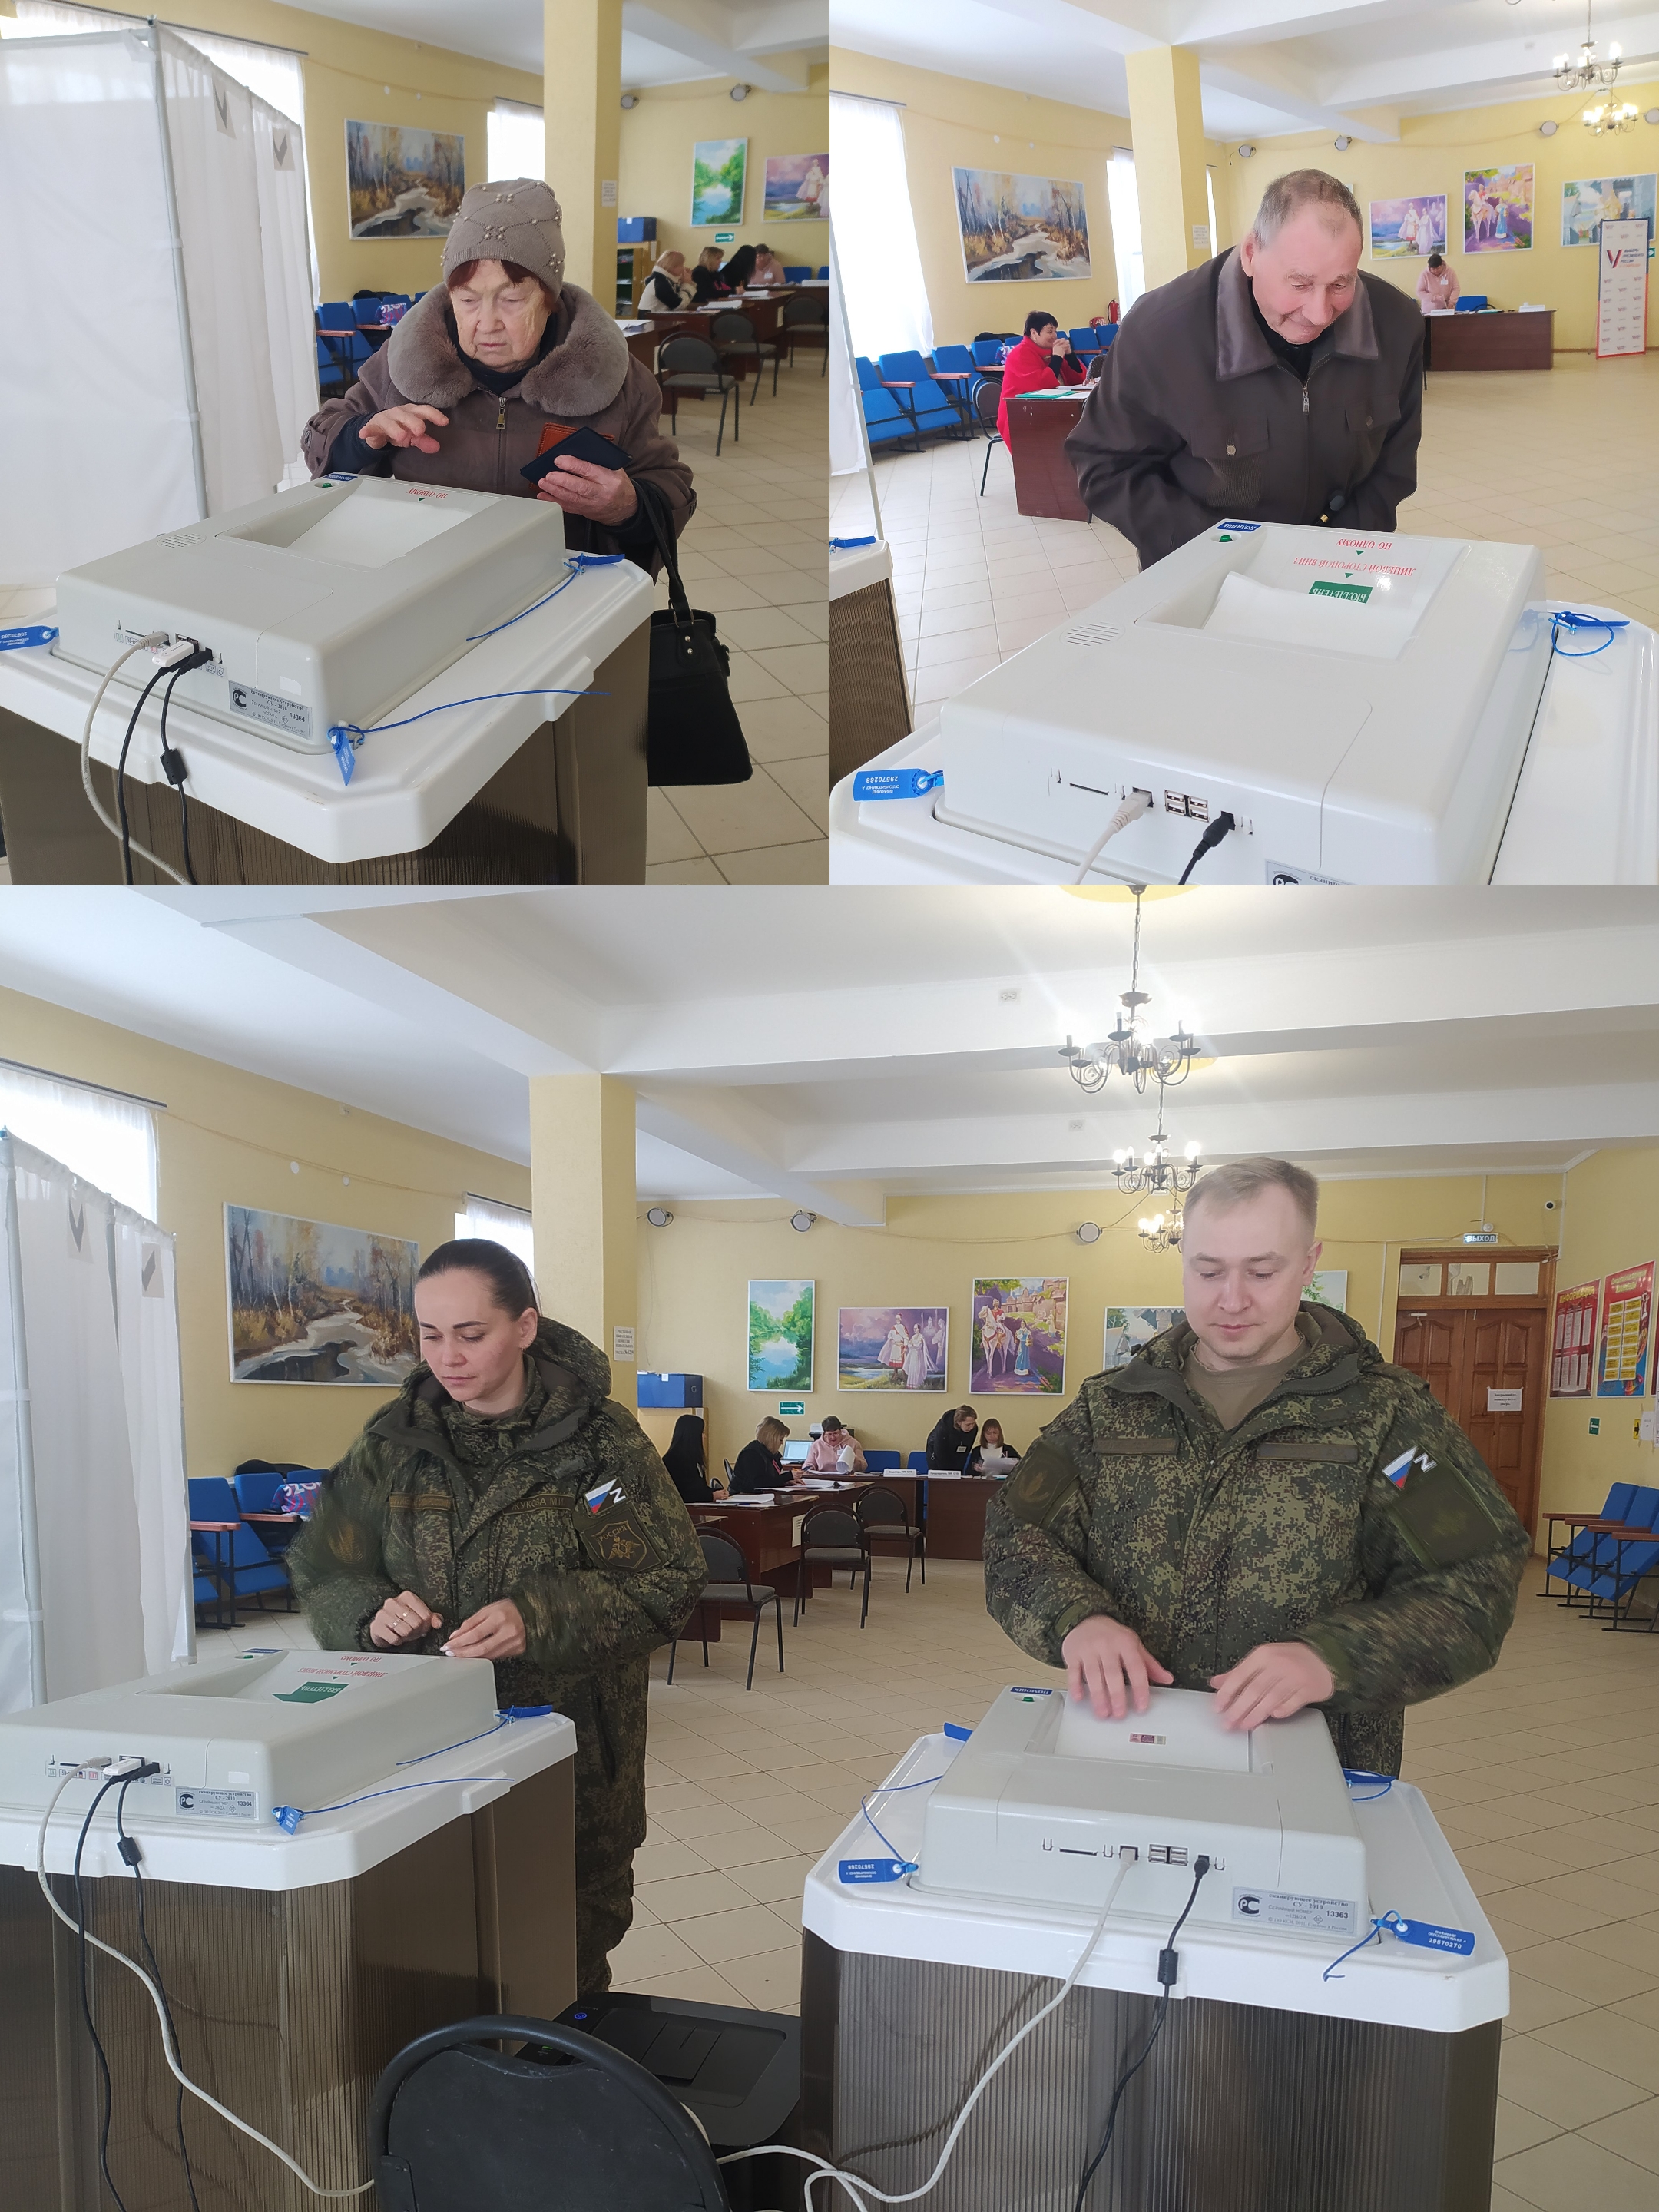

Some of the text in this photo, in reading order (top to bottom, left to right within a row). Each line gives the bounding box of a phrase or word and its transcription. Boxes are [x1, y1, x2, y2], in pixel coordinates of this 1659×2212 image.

[1336, 538, 1393, 550] ПО ОДНОМУ
[1293, 557, 1416, 576] ЛИЦЕВОЙ СТОРОНОЙ ВНИЗ
[599, 1525, 627, 1541] РОССИЯ
[1326, 1910, 1349, 1919] 13363
